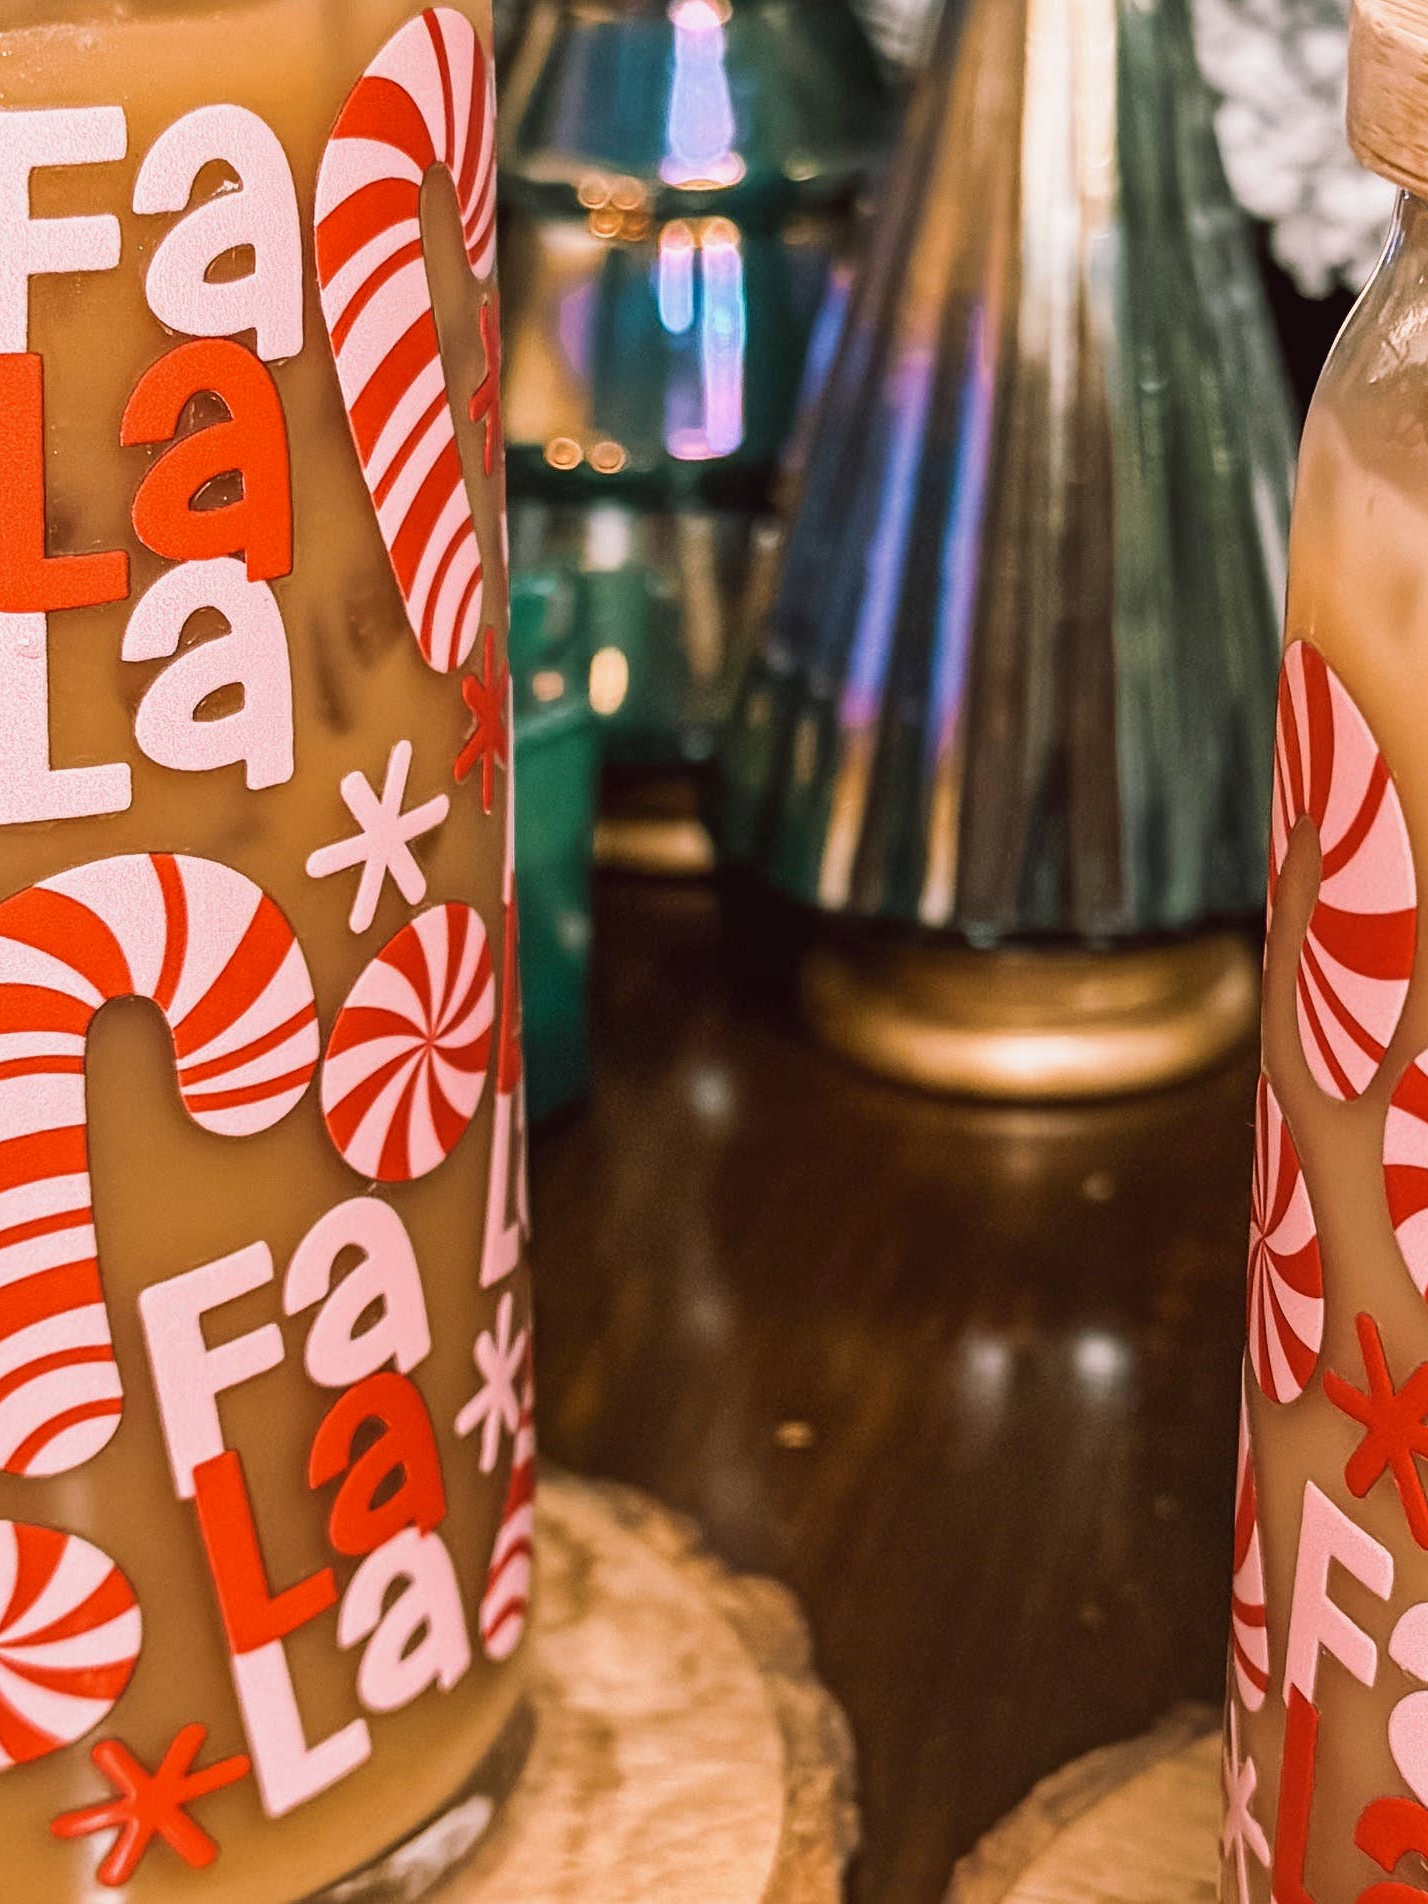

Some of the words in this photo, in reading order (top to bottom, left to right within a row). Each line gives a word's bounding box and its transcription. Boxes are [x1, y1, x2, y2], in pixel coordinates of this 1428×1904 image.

[137, 1194, 432, 1501] Fa
[194, 1368, 448, 1656] La
[228, 1526, 472, 1818] La
